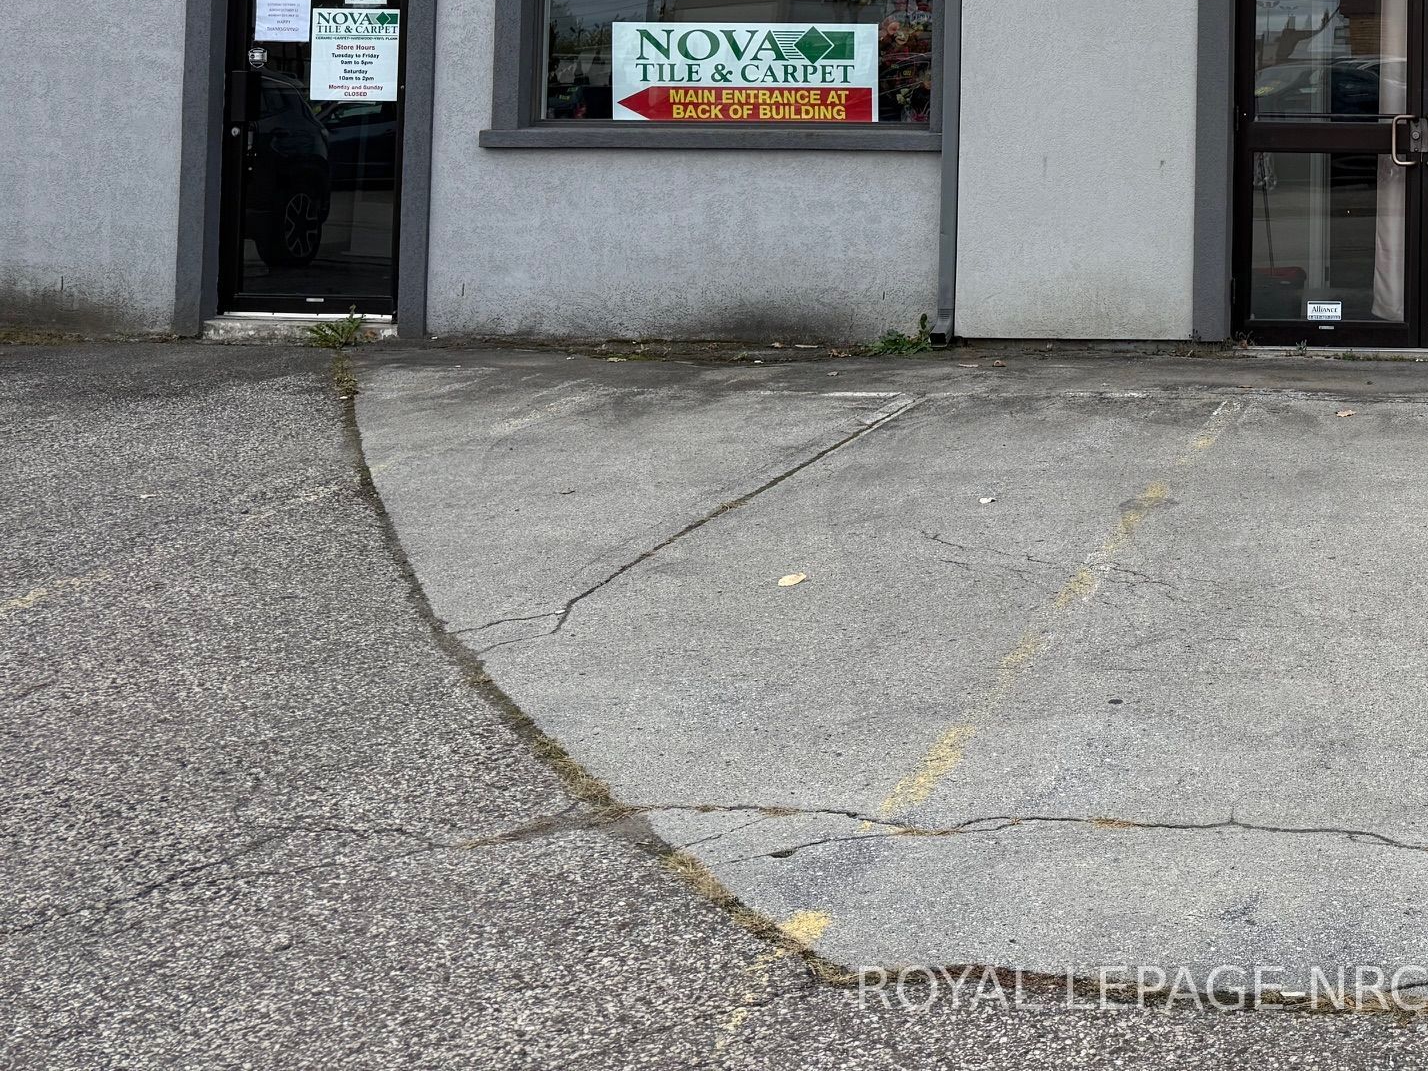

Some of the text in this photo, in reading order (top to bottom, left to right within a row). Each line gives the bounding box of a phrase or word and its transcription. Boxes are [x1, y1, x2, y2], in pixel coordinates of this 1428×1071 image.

[317, 12, 374, 25] NOVA
[344, 26, 353, 34] &
[356, 26, 398, 34] CARPET
[636, 28, 789, 62] NOVA
[636, 62, 855, 84] TILE & CARPET
[669, 89, 849, 104] MAIN ENTRANCE AT
[672, 105, 846, 120] BACK OF BUILDING
